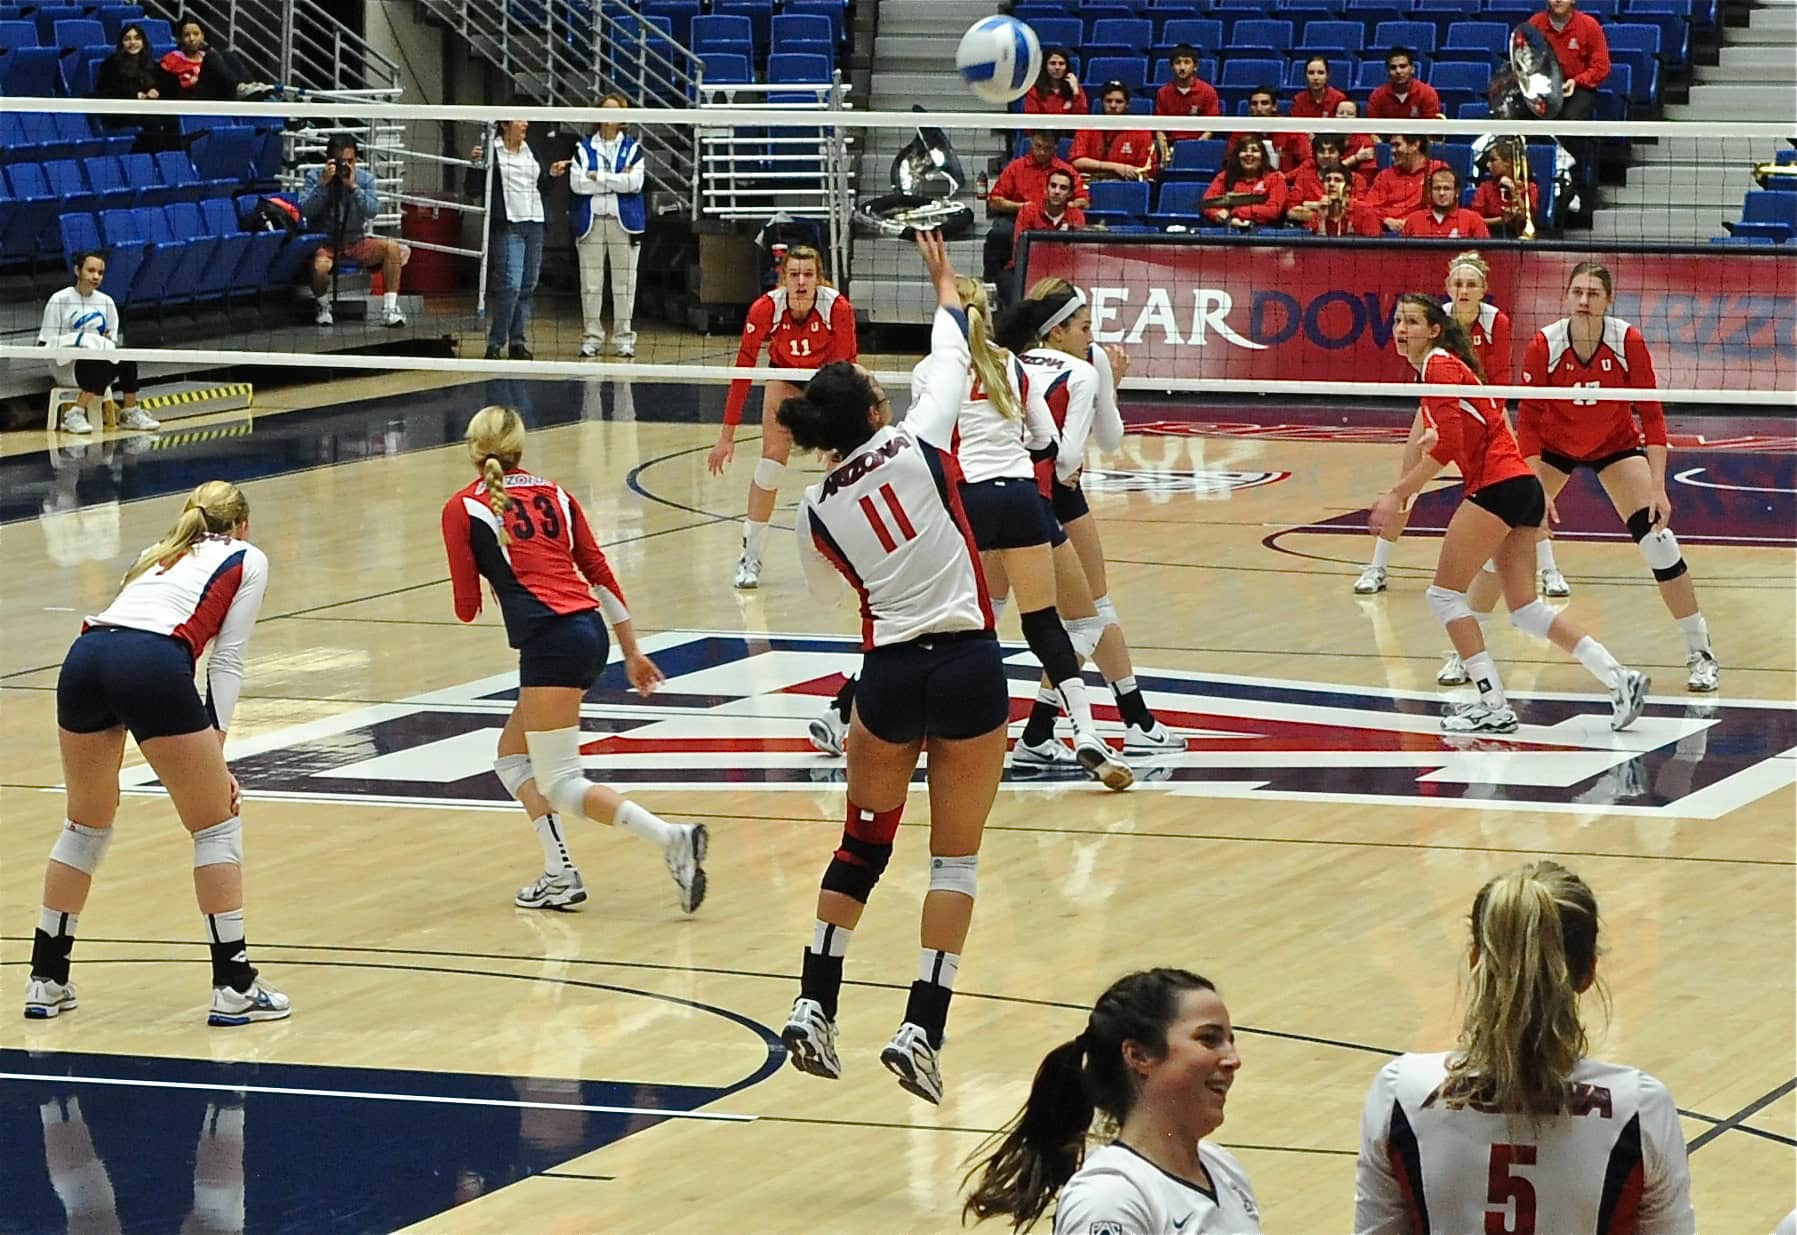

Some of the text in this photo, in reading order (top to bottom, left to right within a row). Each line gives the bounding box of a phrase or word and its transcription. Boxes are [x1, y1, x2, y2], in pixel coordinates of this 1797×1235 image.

[790, 339, 812, 356] 11
[1074, 287, 1268, 349] EAR
[504, 495, 560, 539] 33
[858, 482, 917, 554] 11
[1484, 1143, 1537, 1235] 5
